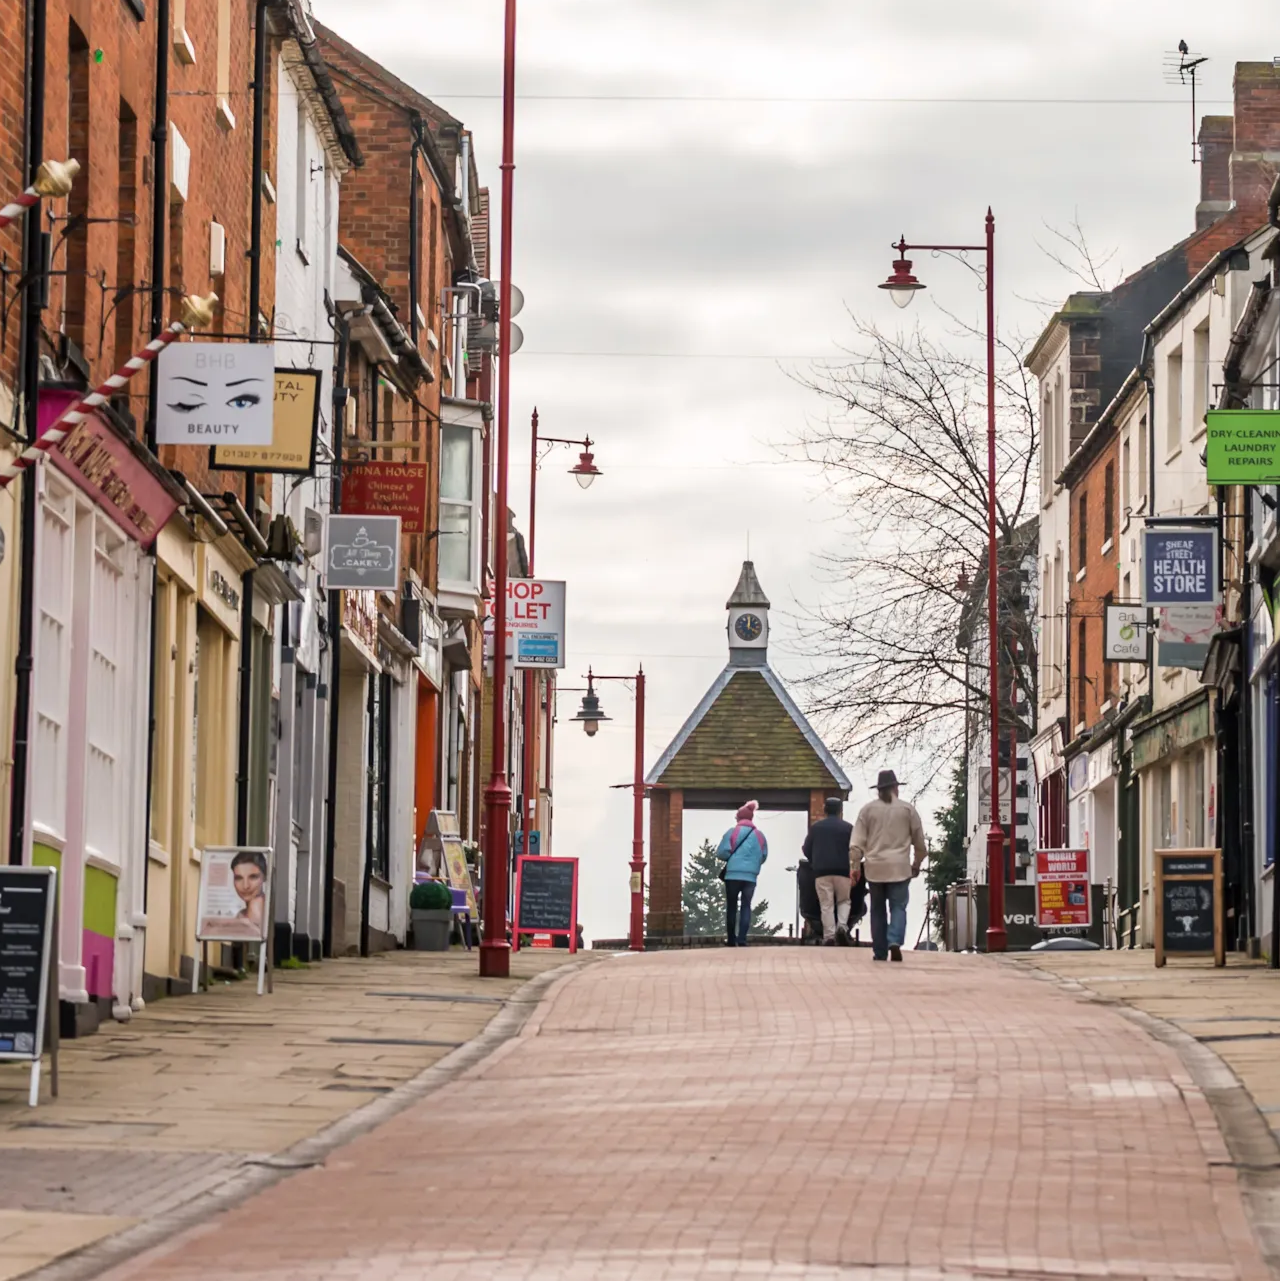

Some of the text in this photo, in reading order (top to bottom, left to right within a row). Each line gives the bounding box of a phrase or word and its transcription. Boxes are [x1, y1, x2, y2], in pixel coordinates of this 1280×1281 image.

[187, 423, 239, 435] BEAUTY
[1224, 444, 1276, 452] LAUNDRY
[1228, 457, 1274, 466] REPAIRS
[385, 466, 424, 478] HOUSE
[1165, 540, 1194, 551] SHEAF
[1166, 549, 1193, 559] STREET
[1153, 559, 1206, 575] HEALTH
[1153, 575, 1206, 593] STORE
[514, 601, 551, 620] LET
[1118, 612, 1137, 622] art
[1047, 862, 1077, 871] WORLD
